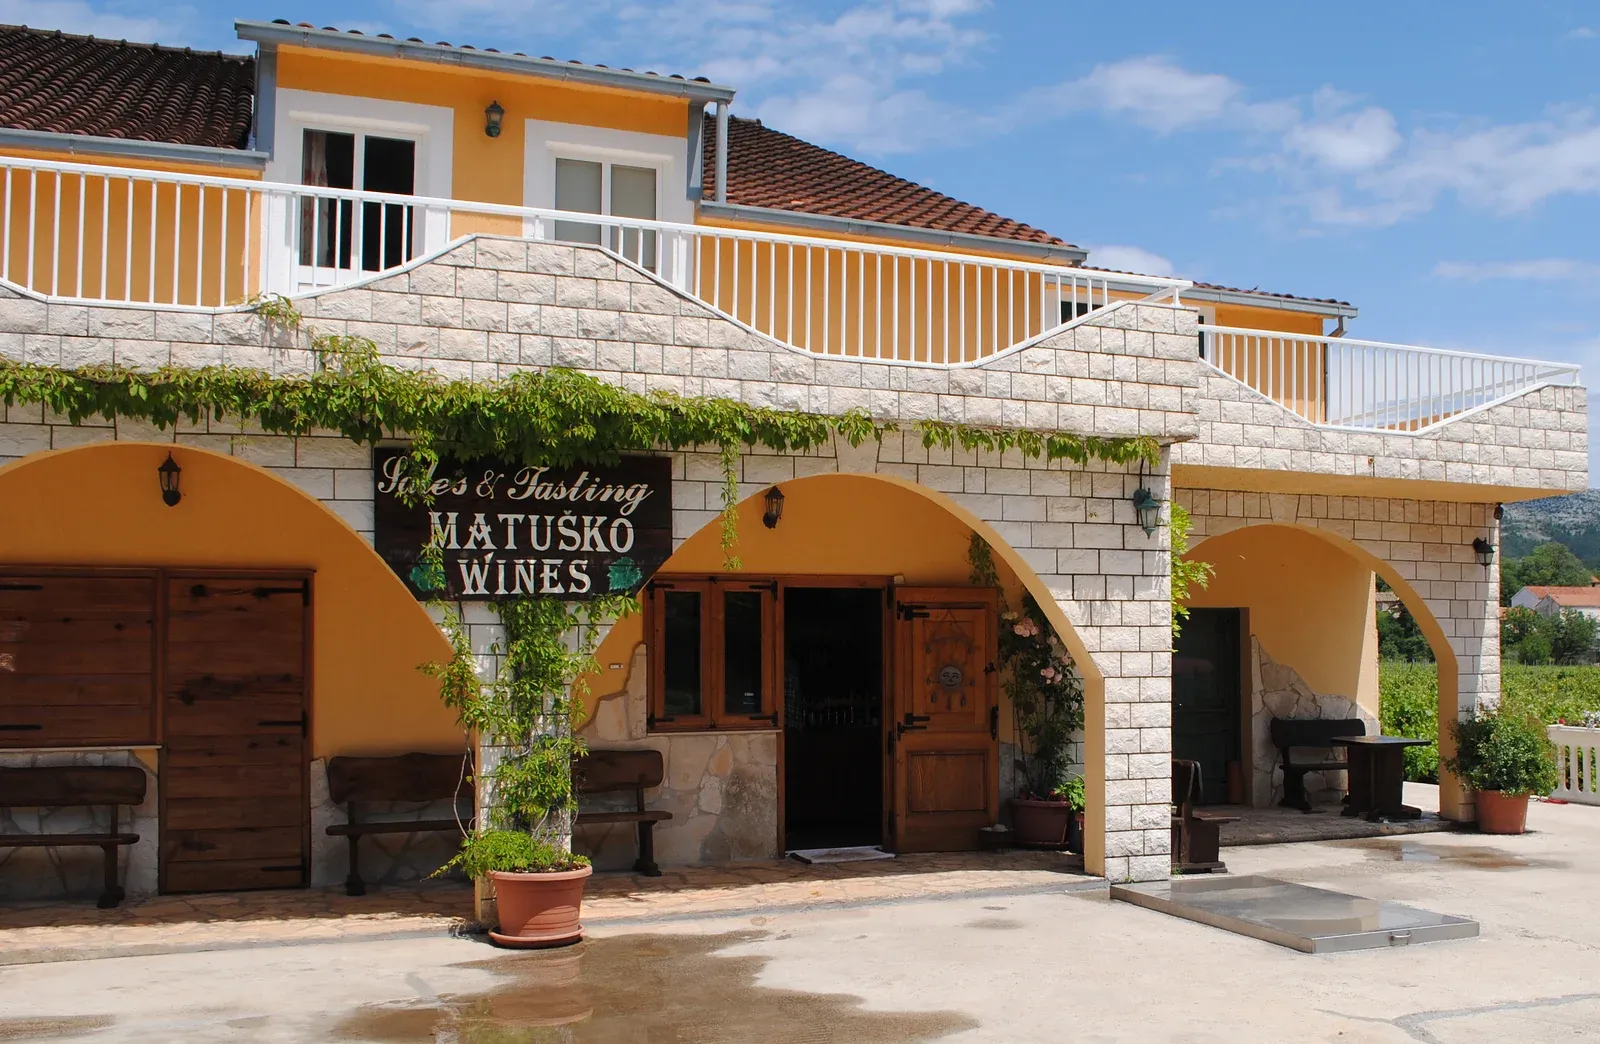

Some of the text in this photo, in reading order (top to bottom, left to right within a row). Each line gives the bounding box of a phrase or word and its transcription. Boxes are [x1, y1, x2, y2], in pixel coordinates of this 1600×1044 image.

[377, 455, 654, 516] Sales & Tasting
[428, 509, 635, 554] MATUŠKO
[456, 551, 592, 596] WINES
